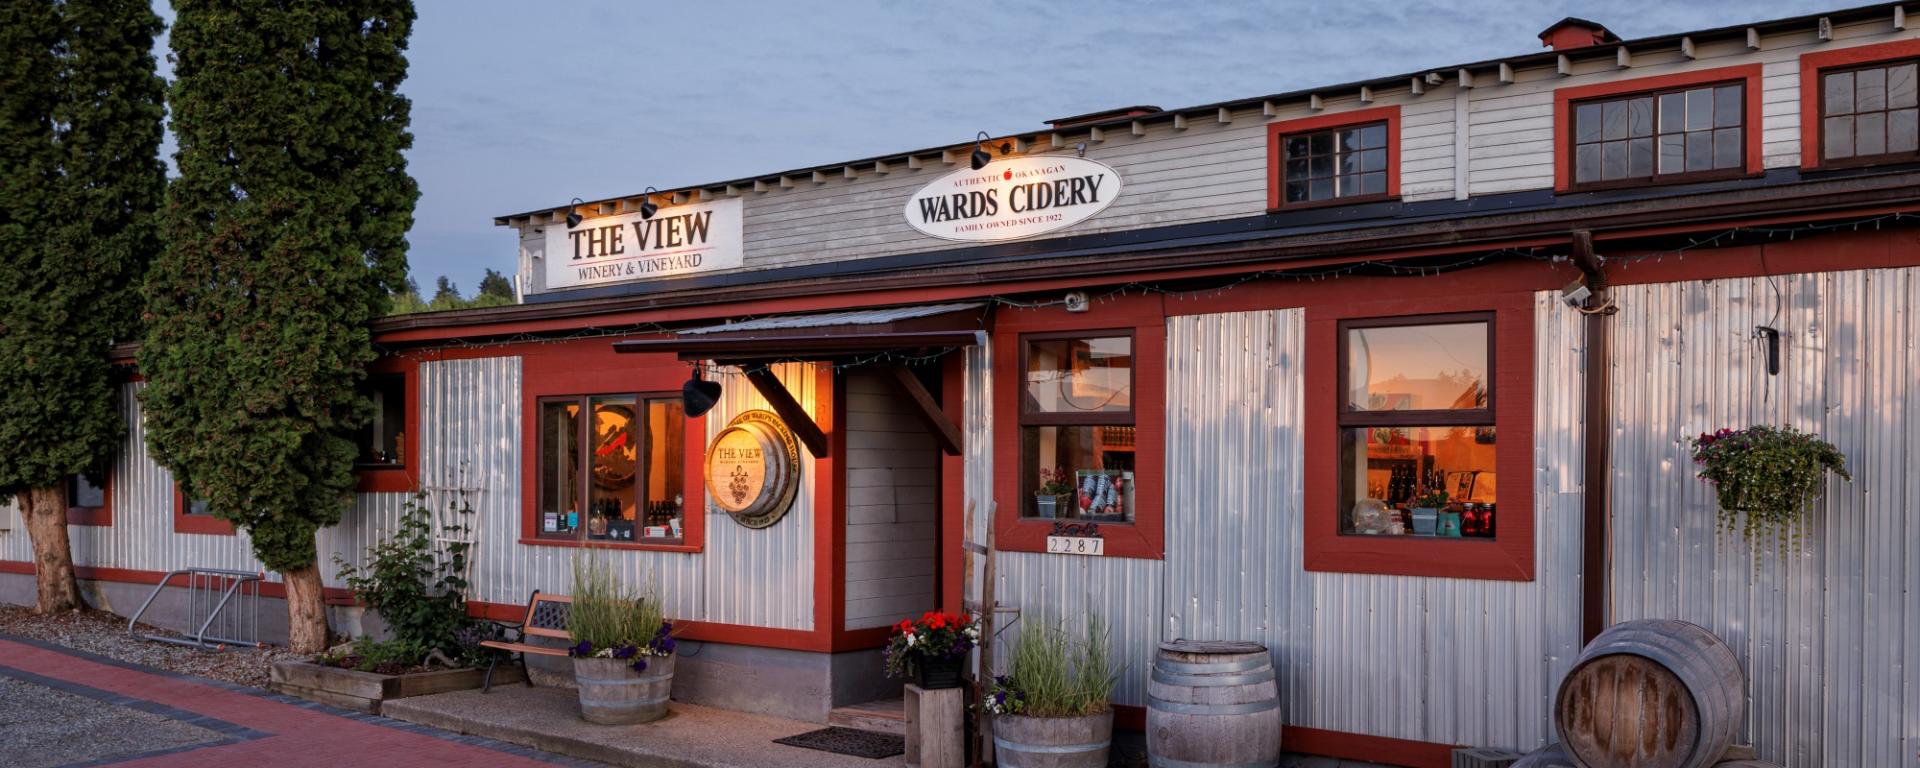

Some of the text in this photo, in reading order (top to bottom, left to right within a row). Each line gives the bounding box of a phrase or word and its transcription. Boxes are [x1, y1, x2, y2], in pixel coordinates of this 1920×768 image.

[953, 164, 1066, 188] AUTHENTIC OKANAGAN
[919, 173, 1104, 224] WARDS CIDERY
[568, 210, 713, 260] THE VIEW
[955, 213, 1063, 233] FAMILY OWNED SINCE 1922
[578, 253, 703, 281] WINERY & VINEYARD
[719, 447, 761, 459] THE VIEW
[1051, 538, 1099, 553] 2287
